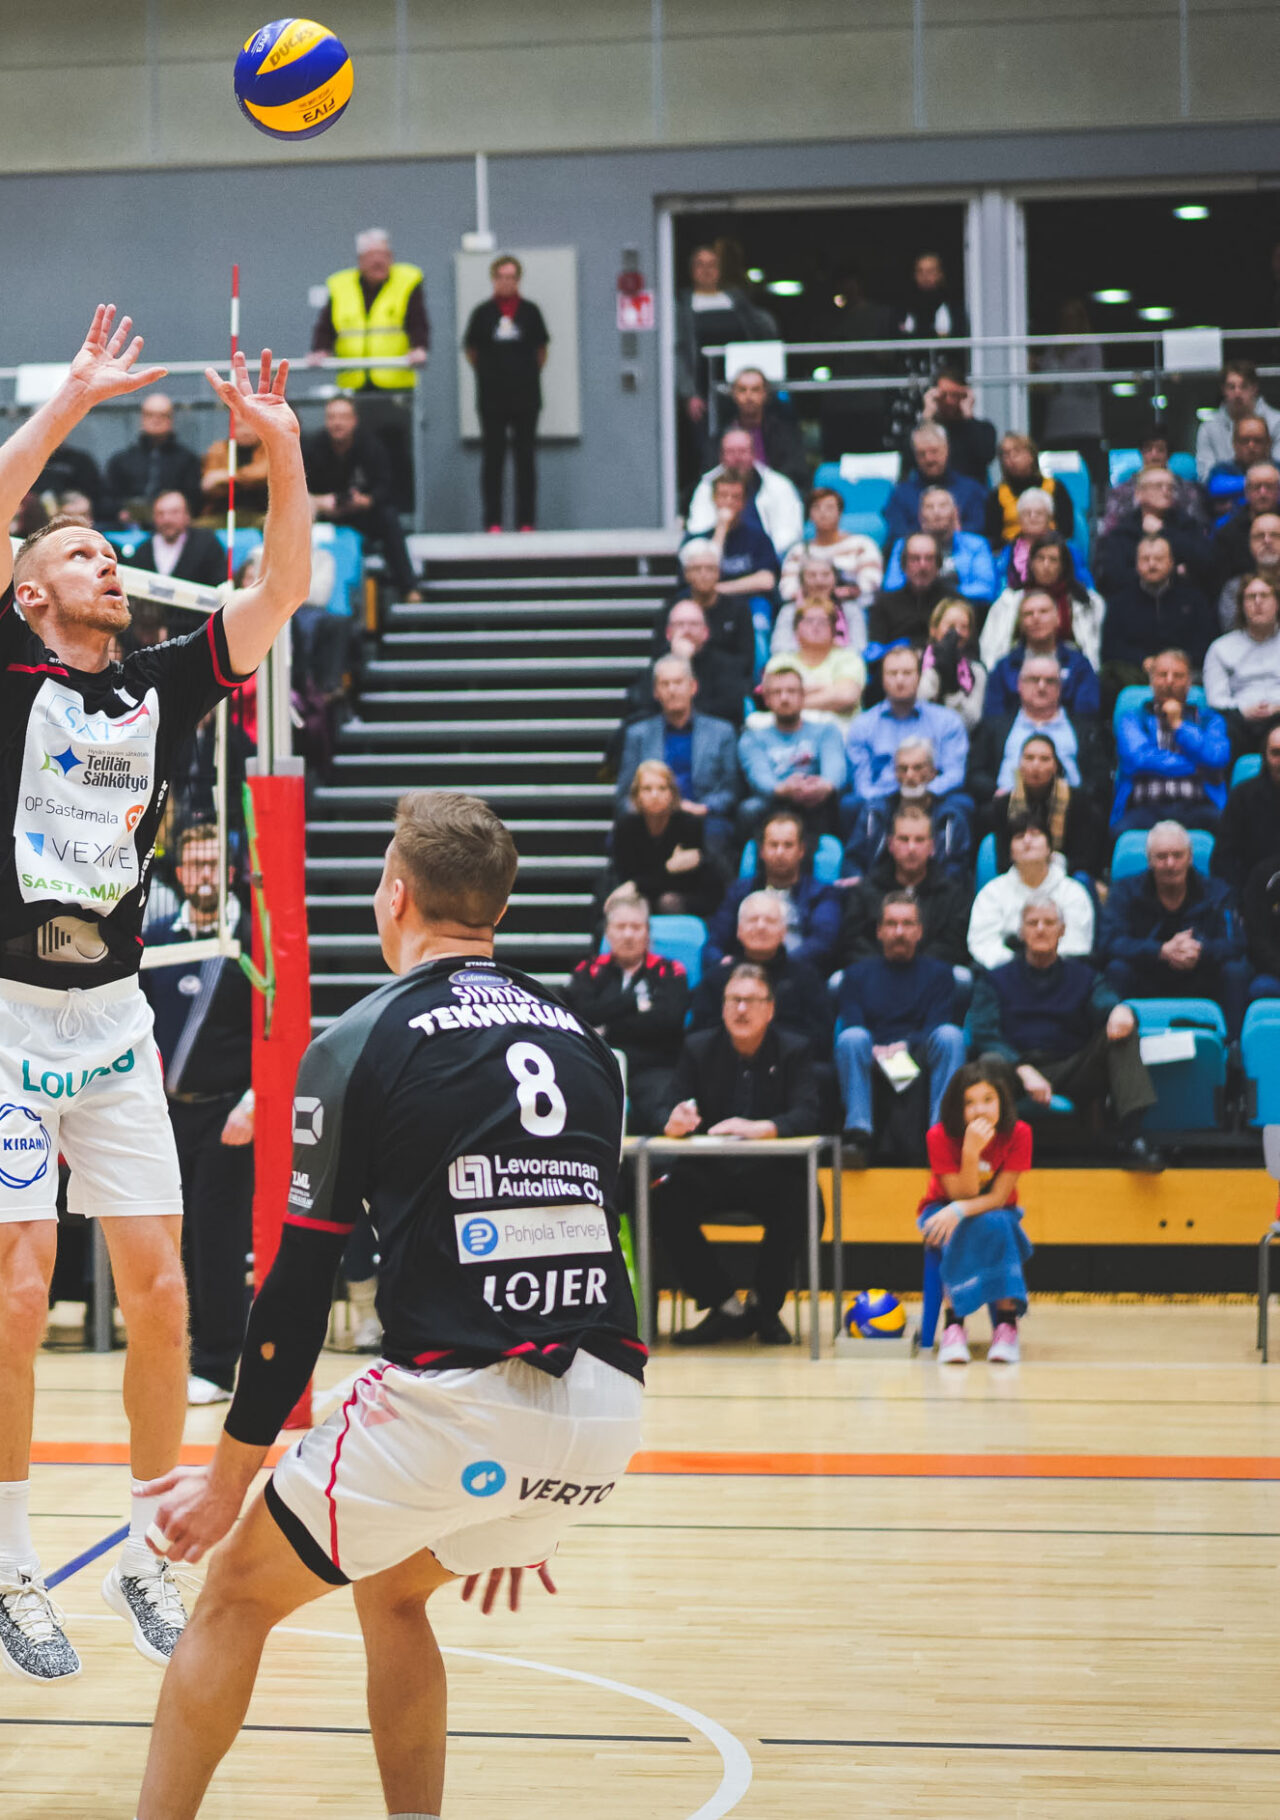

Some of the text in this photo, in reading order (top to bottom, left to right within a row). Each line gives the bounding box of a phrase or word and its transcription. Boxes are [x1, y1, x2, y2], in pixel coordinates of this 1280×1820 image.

[86, 754, 131, 772] Telilän
[82, 770, 149, 793] Sähkötyö
[25, 796, 119, 825] OP Sastamala
[21, 873, 130, 902] SASTAMAL
[505, 1041, 567, 1137] 8
[494, 1154, 599, 1181] Levorannan
[497, 1177, 605, 1207] Autoliike Oy
[504, 1220, 606, 1245] Pohjola Terveys
[483, 1267, 608, 1316] LOJER
